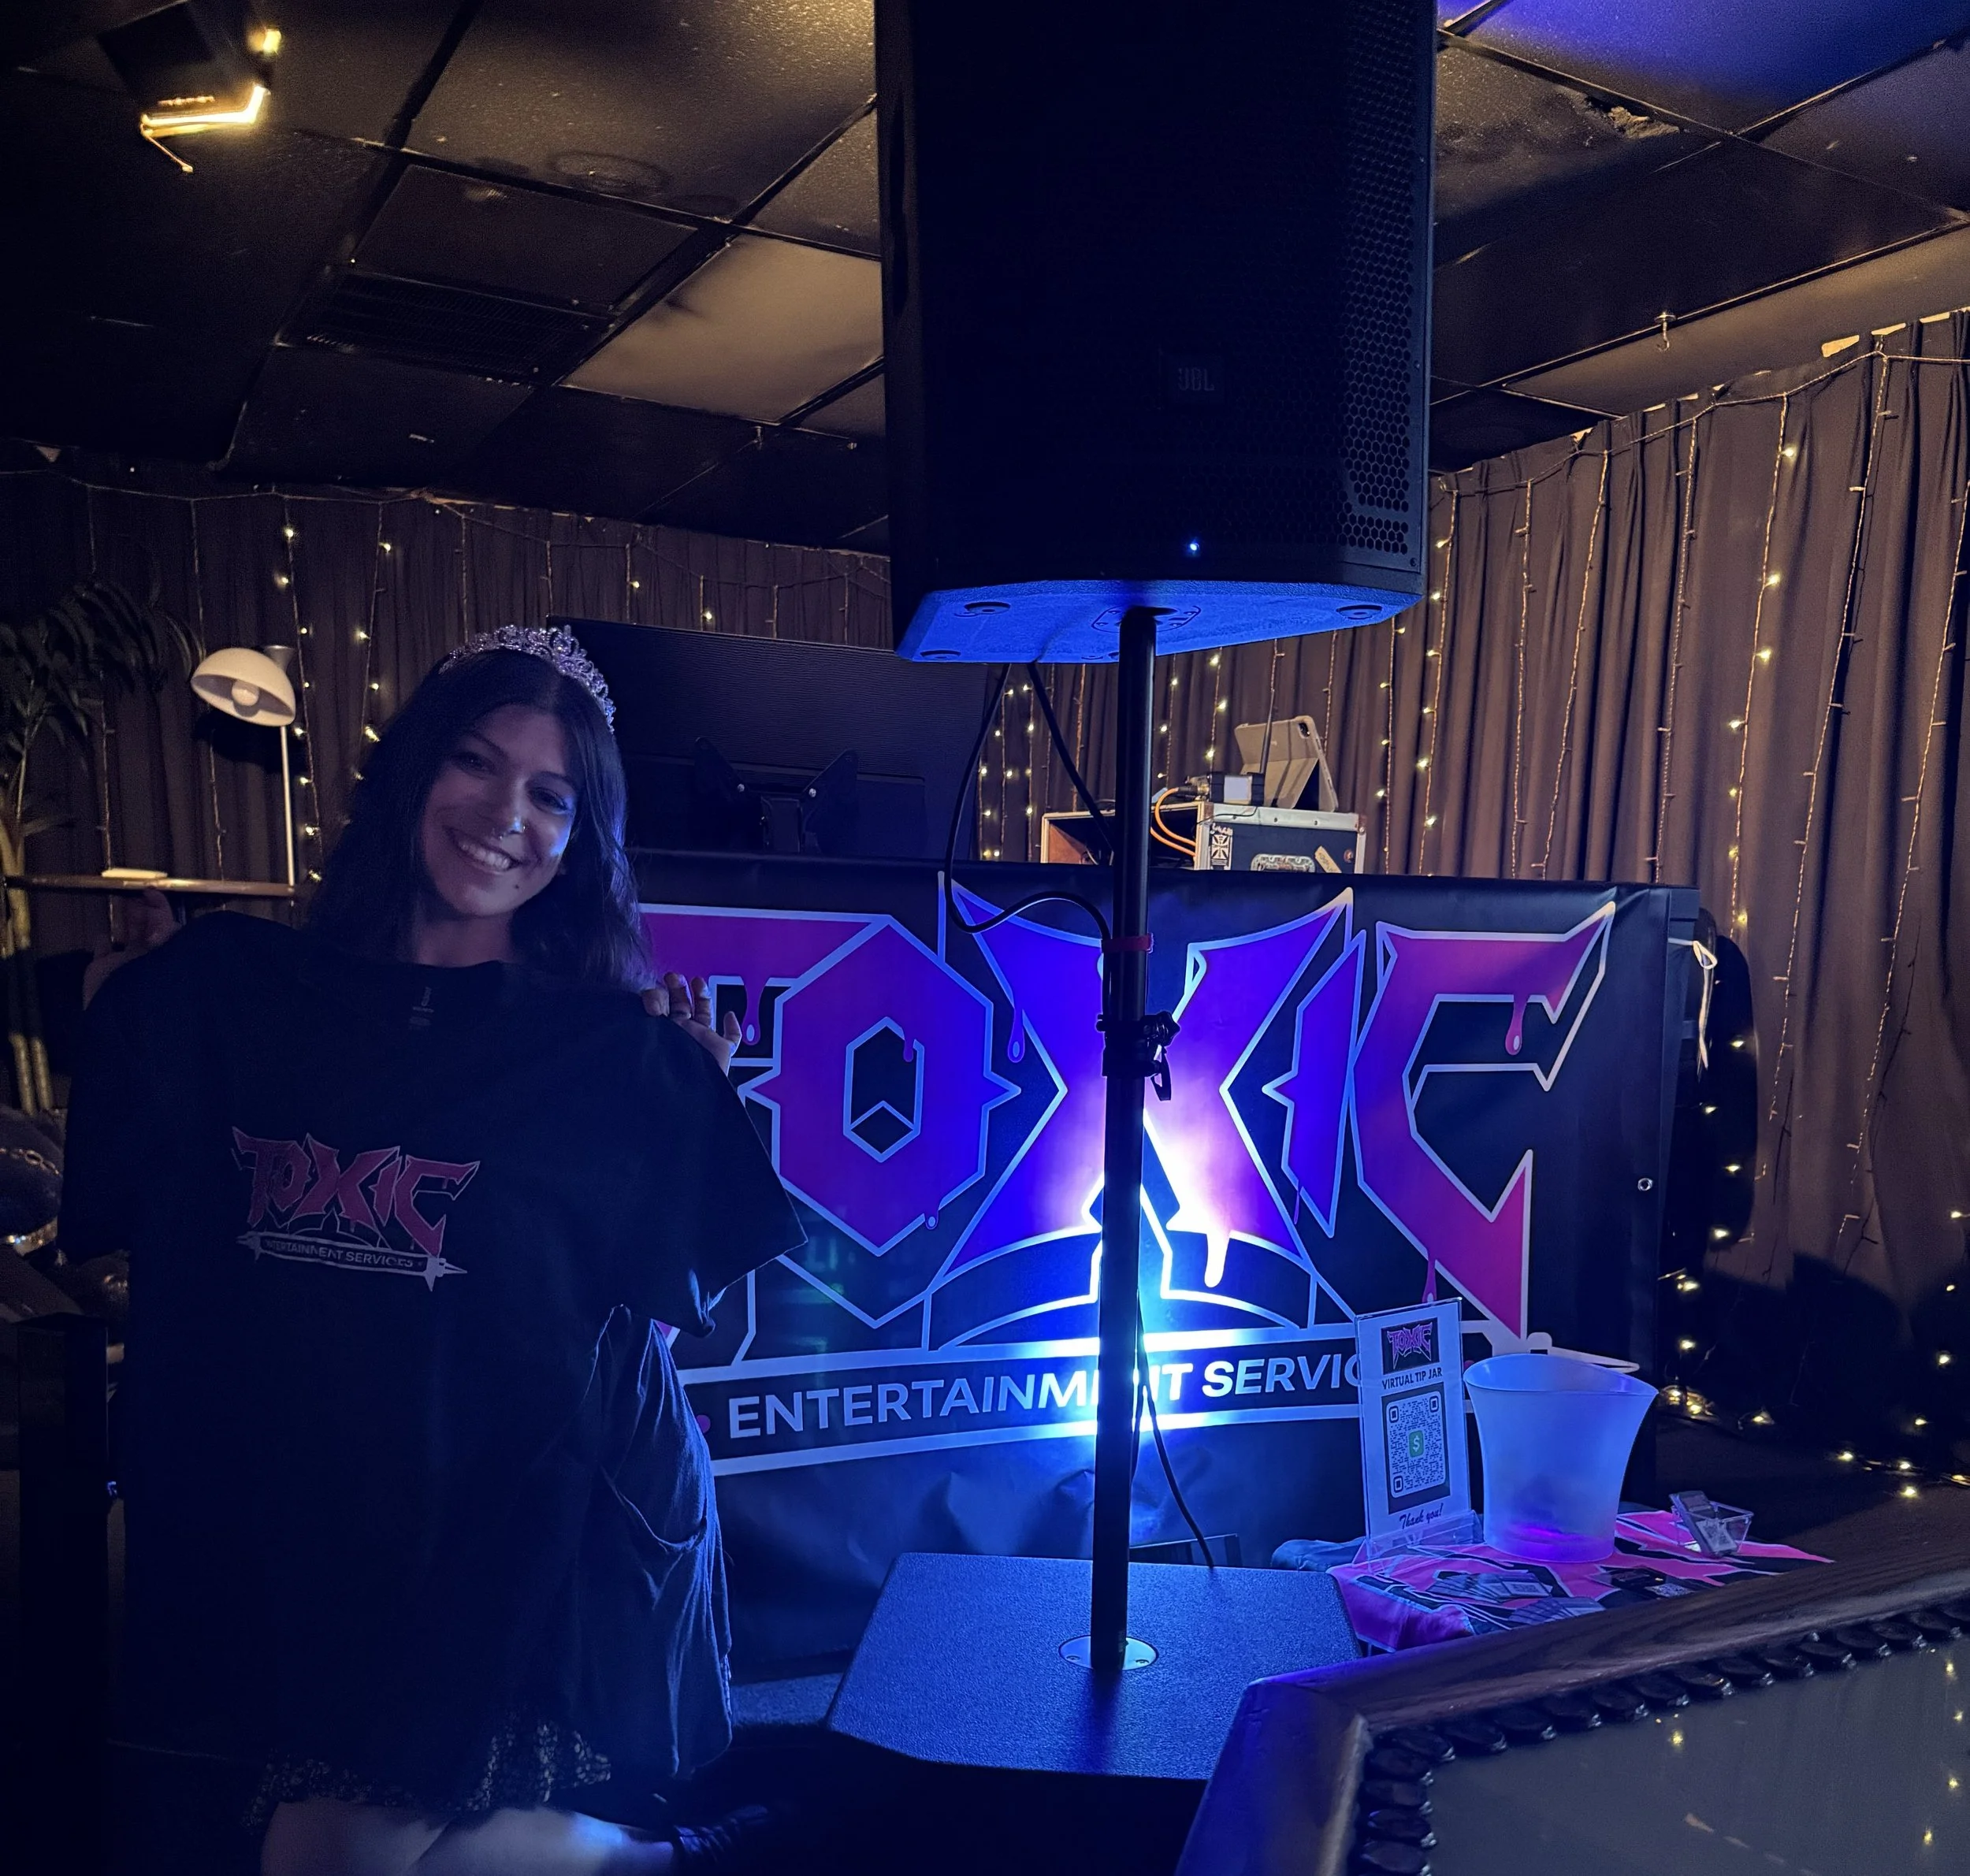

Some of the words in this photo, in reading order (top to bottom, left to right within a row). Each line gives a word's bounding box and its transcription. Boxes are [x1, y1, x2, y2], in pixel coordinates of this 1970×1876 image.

[1177, 367, 1215, 391] JBL
[232, 1126, 481, 1258] TOXIC
[1381, 1373, 1414, 1390] VIRTUAL
[1414, 1370, 1426, 1383] TIP
[1428, 1366, 1443, 1380] JAR
[1399, 1509, 1425, 1529] Thank
[1426, 1503, 1444, 1524] you!
